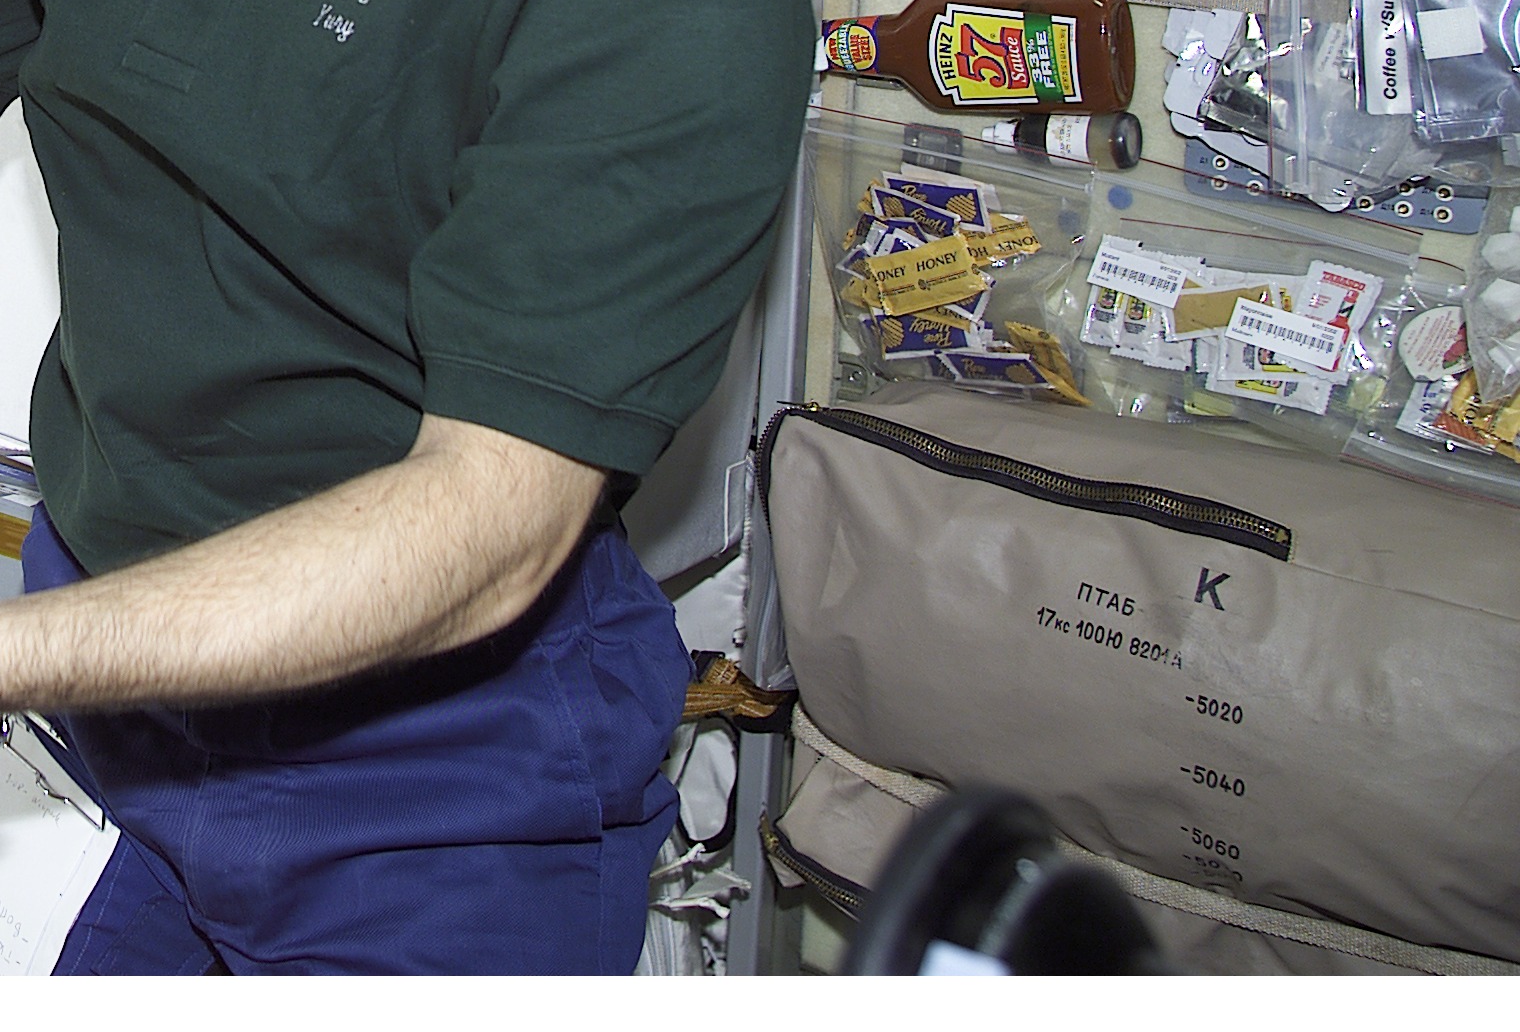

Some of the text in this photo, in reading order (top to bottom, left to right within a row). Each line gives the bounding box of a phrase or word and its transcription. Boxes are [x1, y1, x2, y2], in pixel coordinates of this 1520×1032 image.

[941, 32, 959, 81] HEINZ
[954, 22, 1009, 89] 57
[1006, 35, 1029, 84] Sauce
[1026, 38, 1043, 84] 33%
[1037, 29, 1057, 89] FREE
[1383, 46, 1399, 100] Coffee
[916, 251, 958, 272] HONEY
[1077, 582, 1137, 616] ПТАБ
[1194, 567, 1231, 611] К
[1076, 620, 1123, 649] 100Ю
[1185, 694, 1243, 724] -5020
[1180, 765, 1245, 797] -5040
[1180, 825, 1240, 860] -5060
